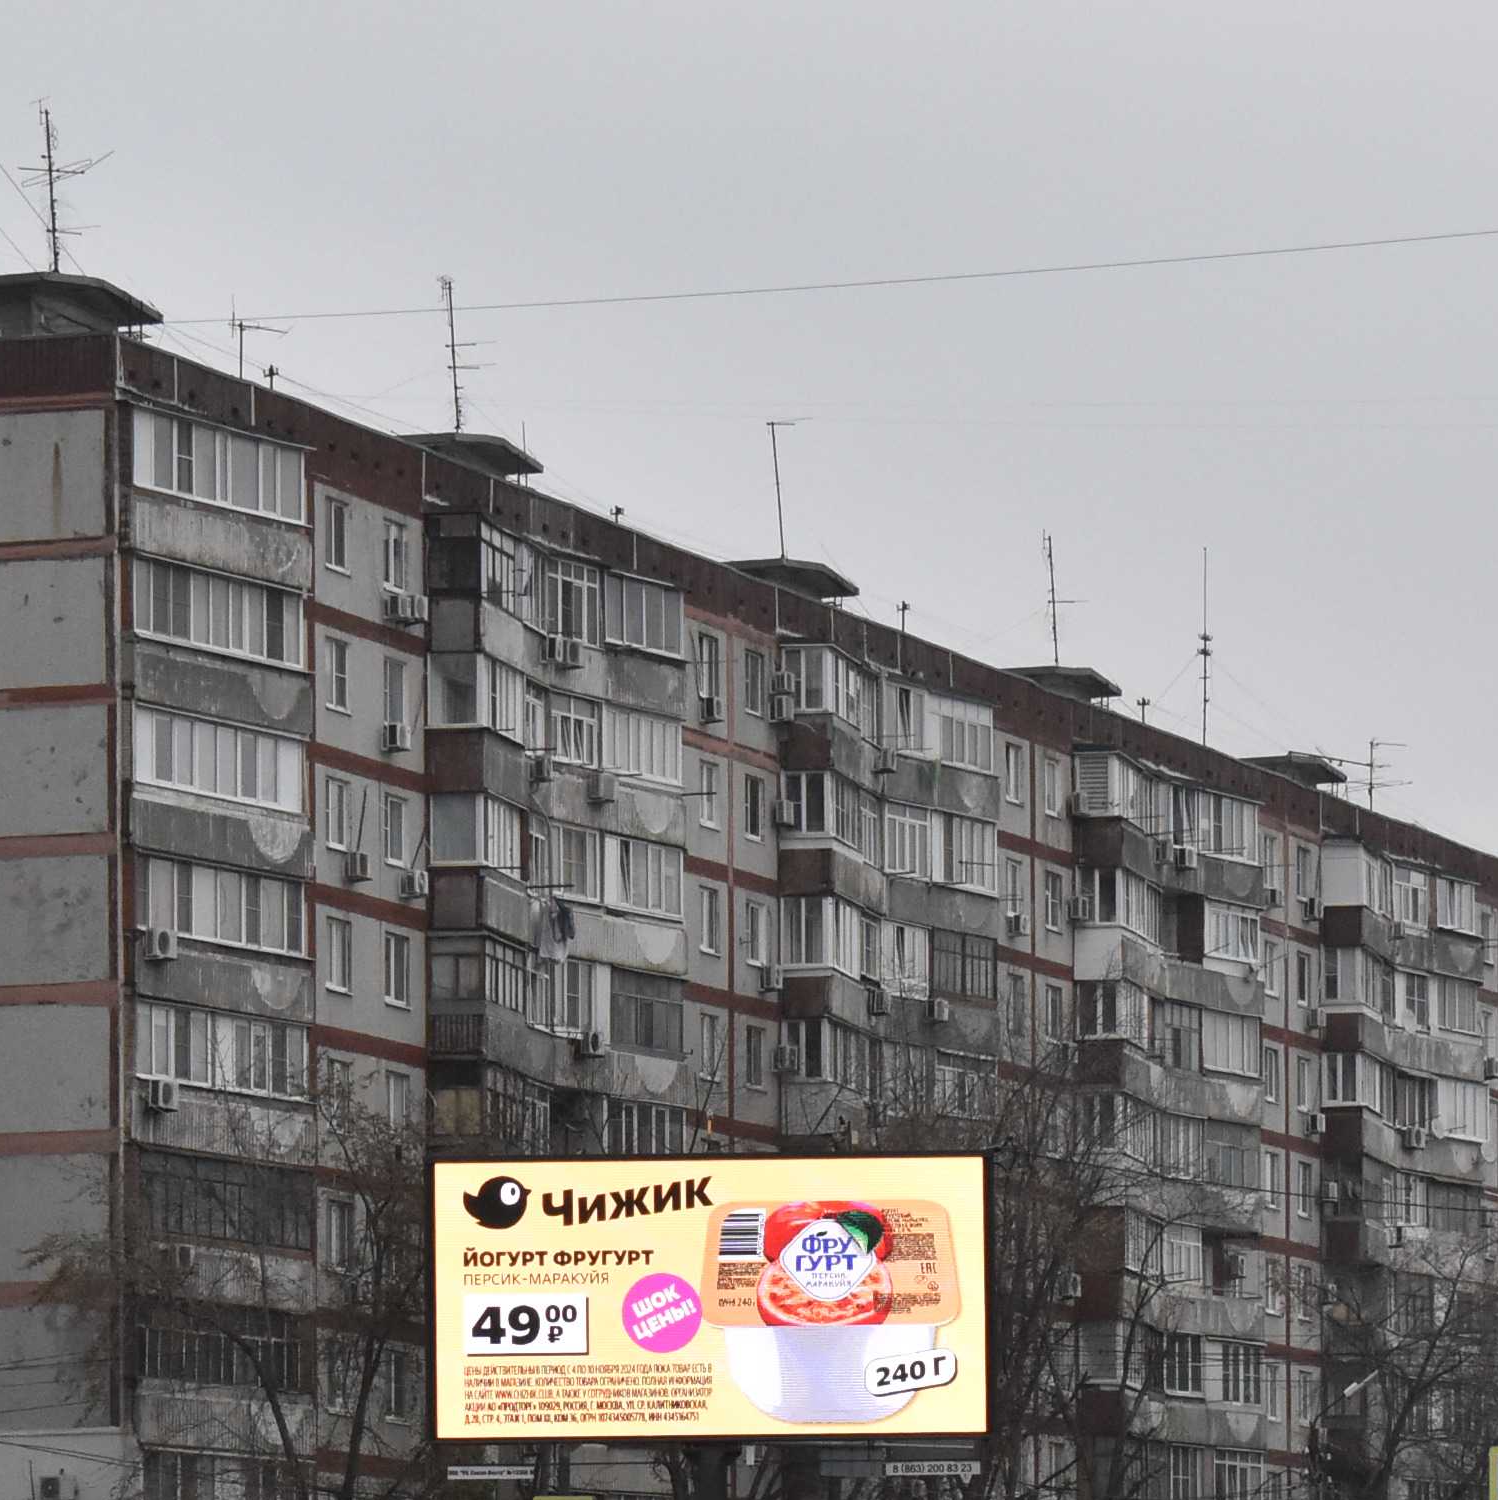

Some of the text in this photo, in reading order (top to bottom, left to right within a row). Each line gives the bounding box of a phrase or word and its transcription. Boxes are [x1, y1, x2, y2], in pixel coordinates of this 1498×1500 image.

[802, 1233, 854, 1254] ФРУ
[463, 1247, 654, 1267] ЙОГУРТ ФРУГУРТ
[795, 1254, 857, 1272] ГУРТ
[463, 1270, 609, 1286] ПЕРСИК-МАРАКУЙЯ
[631, 1283, 681, 1318] ШОК
[472, 1305, 540, 1345] 49
[545, 1304, 577, 1323] 00
[632, 1298, 697, 1341] ЦЕНЫ!
[876, 1360, 925, 1387] 240
[893, 1463, 972, 1473] 8 (863) 200 83 23
